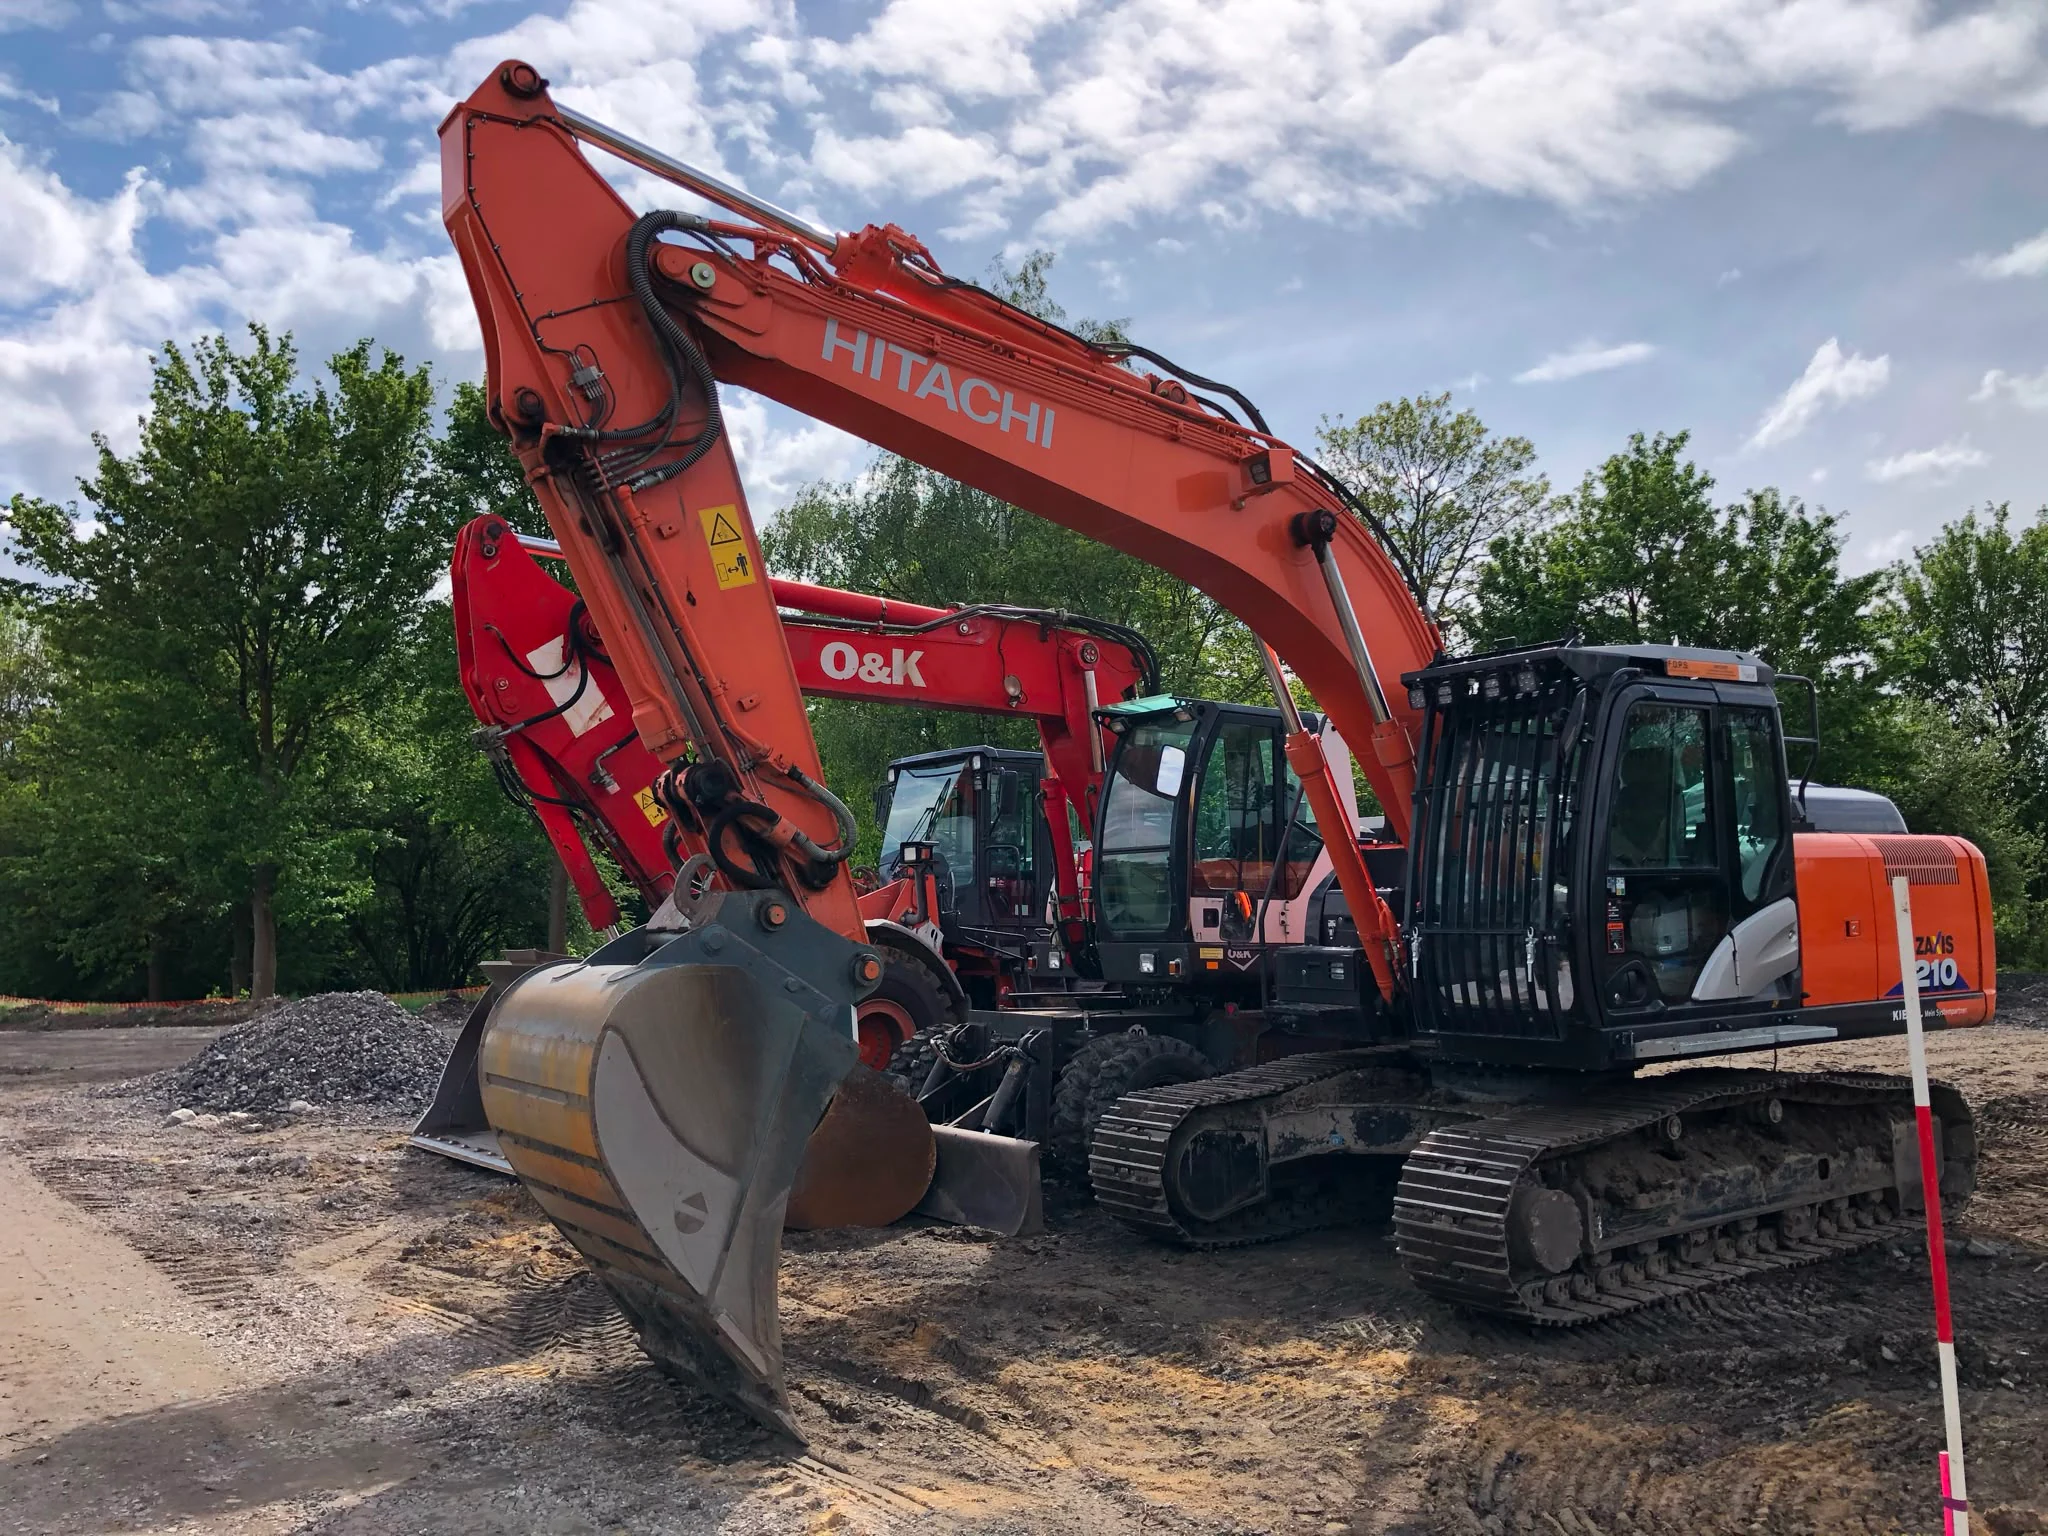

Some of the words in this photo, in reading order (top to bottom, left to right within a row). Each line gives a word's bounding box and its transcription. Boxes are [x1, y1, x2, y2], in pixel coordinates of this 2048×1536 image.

[821, 316, 1056, 449] HITACHI
[820, 641, 927, 688] O&K
[1915, 930, 1954, 955] ZAXIS
[1915, 957, 1958, 987] 210
